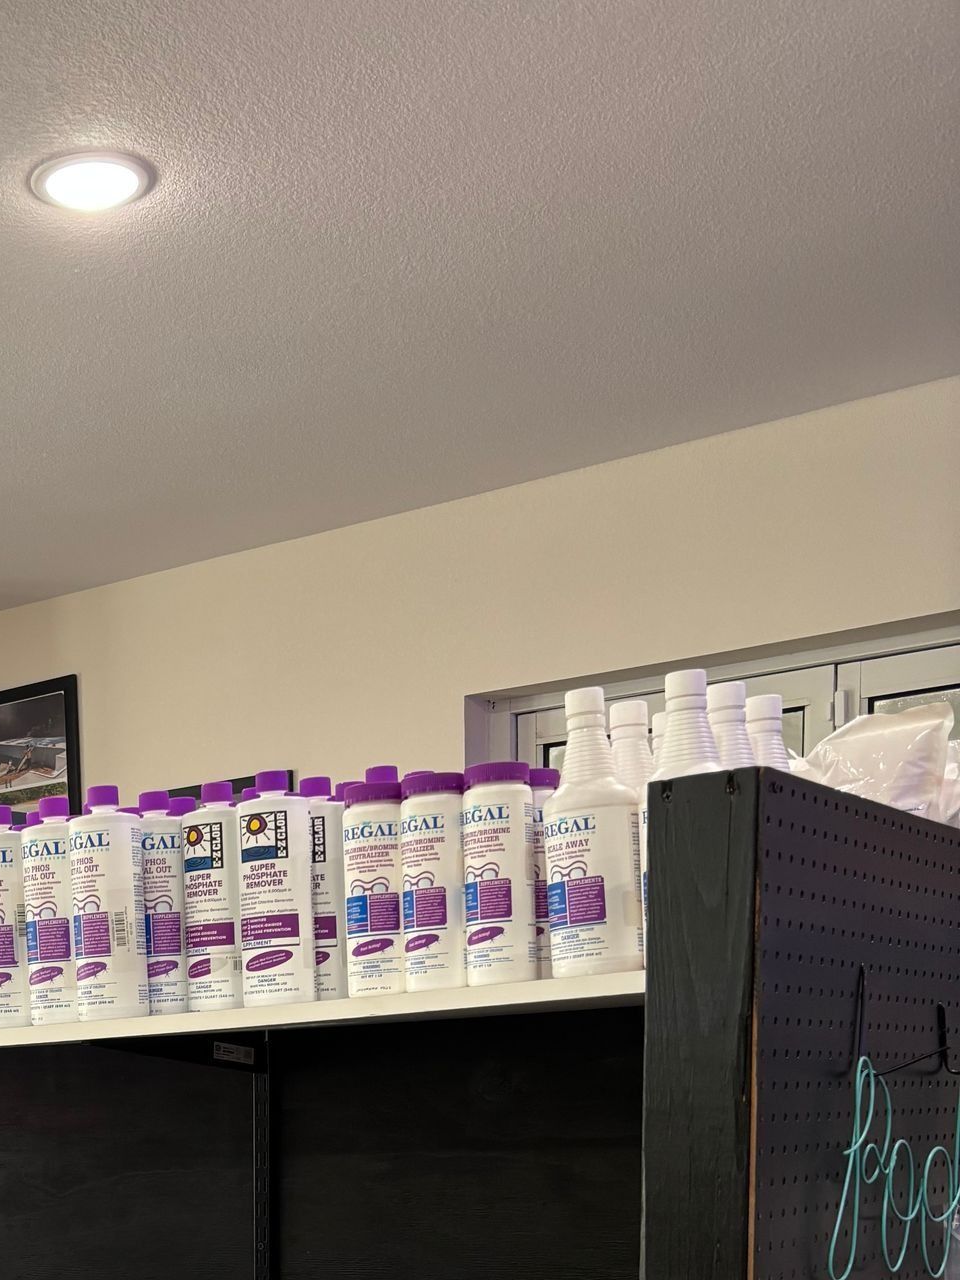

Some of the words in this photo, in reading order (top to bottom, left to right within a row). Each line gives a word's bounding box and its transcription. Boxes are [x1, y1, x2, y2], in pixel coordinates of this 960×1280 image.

[276, 812, 286, 840] CLOR
[314, 816, 324, 844] CLOR
[400, 816, 445, 834] EGAL
[544, 816, 596, 840] REGAL
[212, 822, 222, 850] CLOR
[344, 824, 398, 842] REGAL
[70, 834, 110, 851] EGAL
[142, 833, 180, 851] GAL
[565, 838, 590, 850] AWAY
[76, 857, 94, 866] PHOS
[145, 858, 167, 866] PHOS
[32, 864, 50, 873] PHOS
[84, 865, 100, 873] OUT
[155, 866, 172, 874] OUT
[250, 863, 276, 872] SUPER
[40, 872, 56, 880] OUT
[190, 873, 212, 882] SUPER
[243, 870, 288, 882] PHOSPHATE
[246, 879, 284, 890] REMOVER
[186, 889, 218, 899] REMOVER
